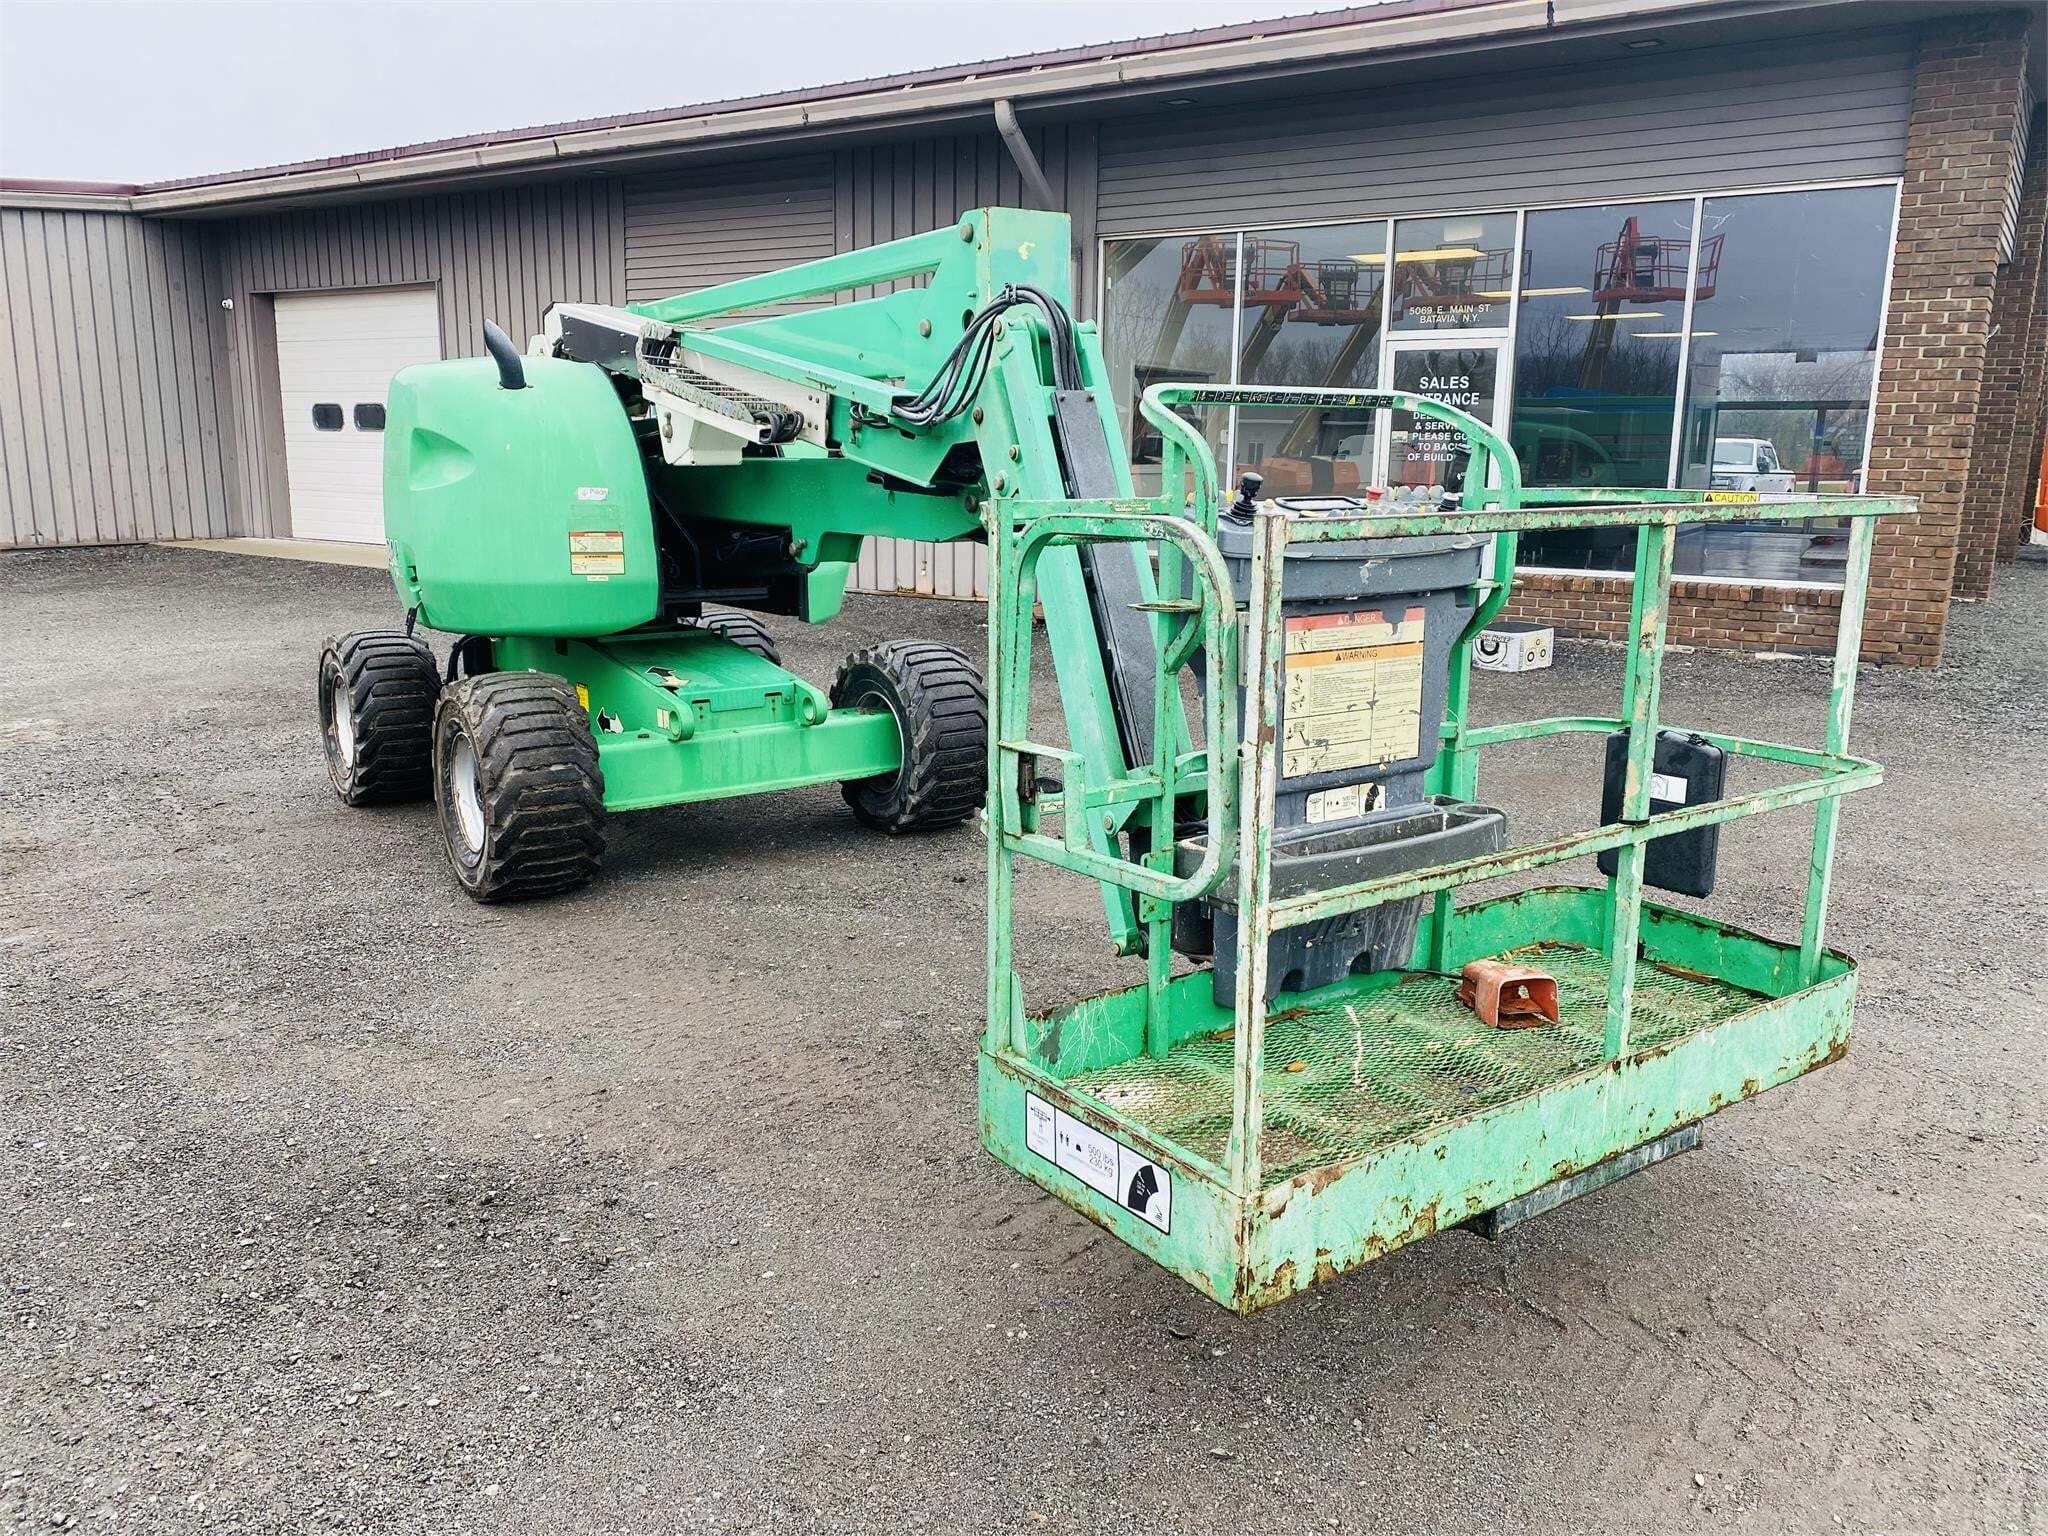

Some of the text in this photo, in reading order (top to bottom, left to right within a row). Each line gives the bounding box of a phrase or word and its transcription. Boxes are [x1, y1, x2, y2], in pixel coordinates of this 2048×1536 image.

[1409, 306, 1433, 315] 5069
[1449, 305, 1474, 313] MAIN
[1478, 303, 1493, 312] ST.
[1420, 314, 1480, 324] BATAVIA, N.Y.
[1420, 376, 1470, 389] SALES
[1415, 422, 1422, 430] &
[1412, 432, 1451, 441] PLEASE
[1418, 442, 1457, 451] TO BAC
[1407, 452, 1421, 461] OF
[1714, 493, 1757, 503] CAUTION
[1345, 613, 1377, 625] DNGER
[1342, 650, 1378, 661] WARNING
[1088, 1143, 1102, 1158] 500
